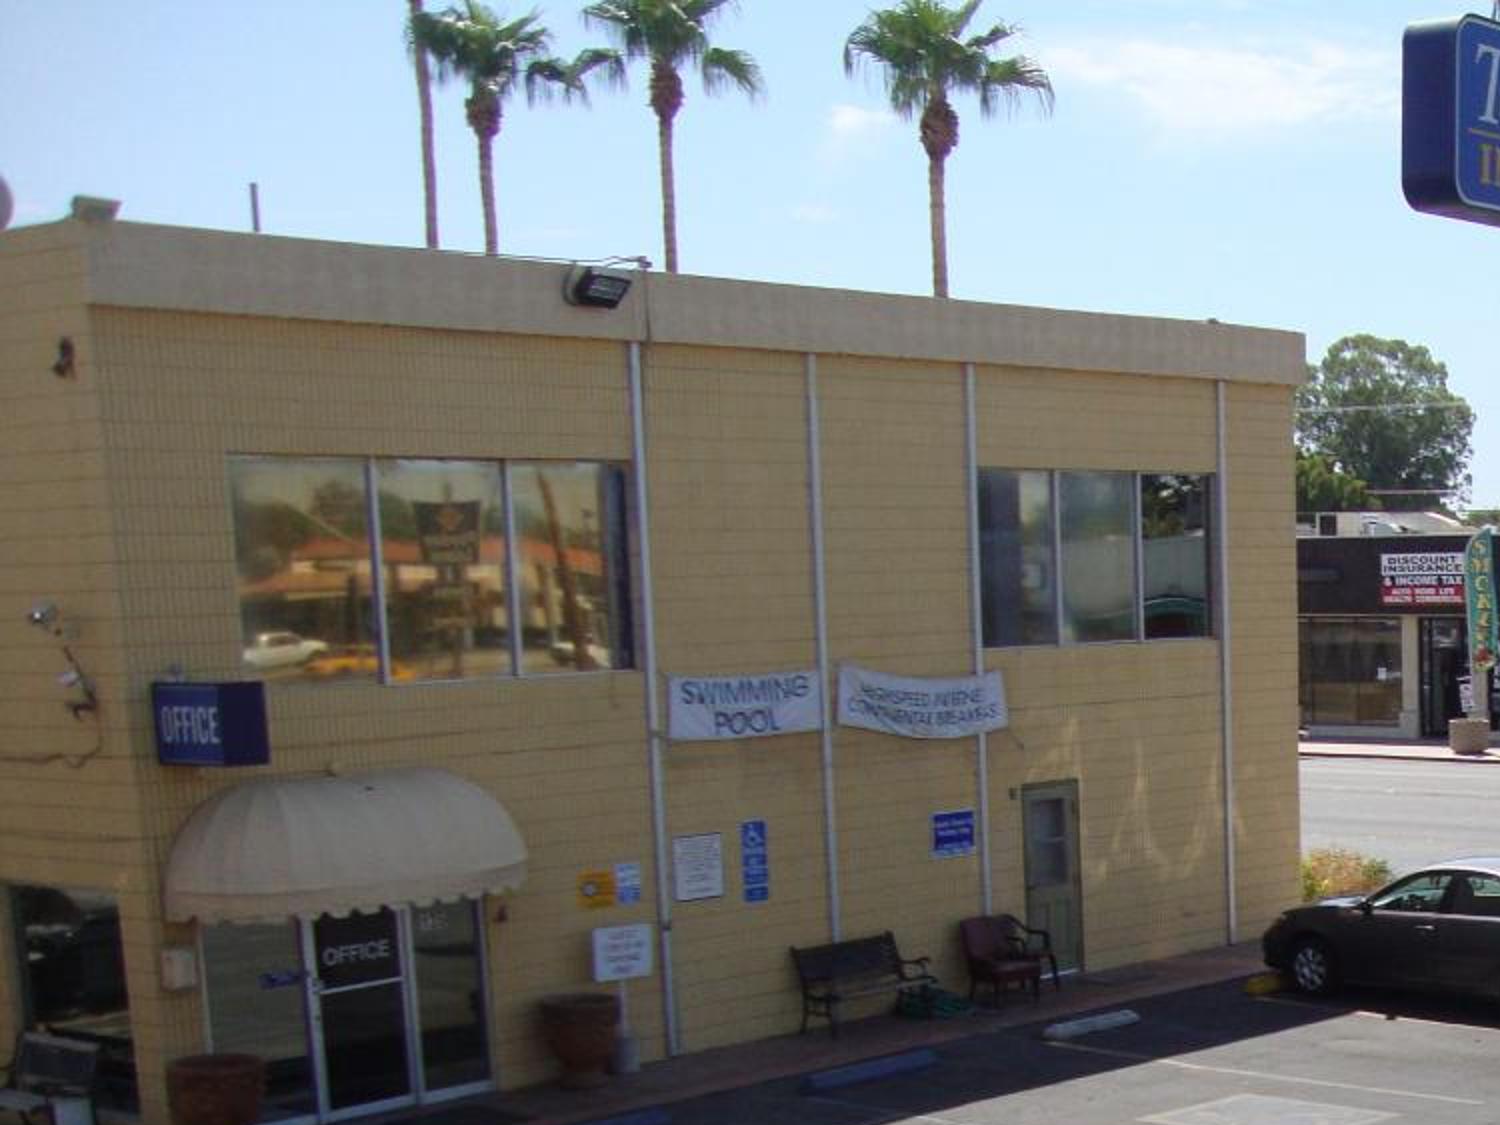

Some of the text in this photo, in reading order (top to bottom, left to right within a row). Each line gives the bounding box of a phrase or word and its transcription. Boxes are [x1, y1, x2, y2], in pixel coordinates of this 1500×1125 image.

[1383, 564, 1463, 573] INSURANCE
[1387, 555, 1456, 565] DISCOUNT
[1396, 576, 1438, 586] INCOME
[1441, 575, 1463, 585] TAX
[681, 675, 809, 705] SWIMMING
[162, 706, 221, 744] OFFICE
[714, 709, 780, 735] POOL
[322, 940, 391, 966] OFFICE
